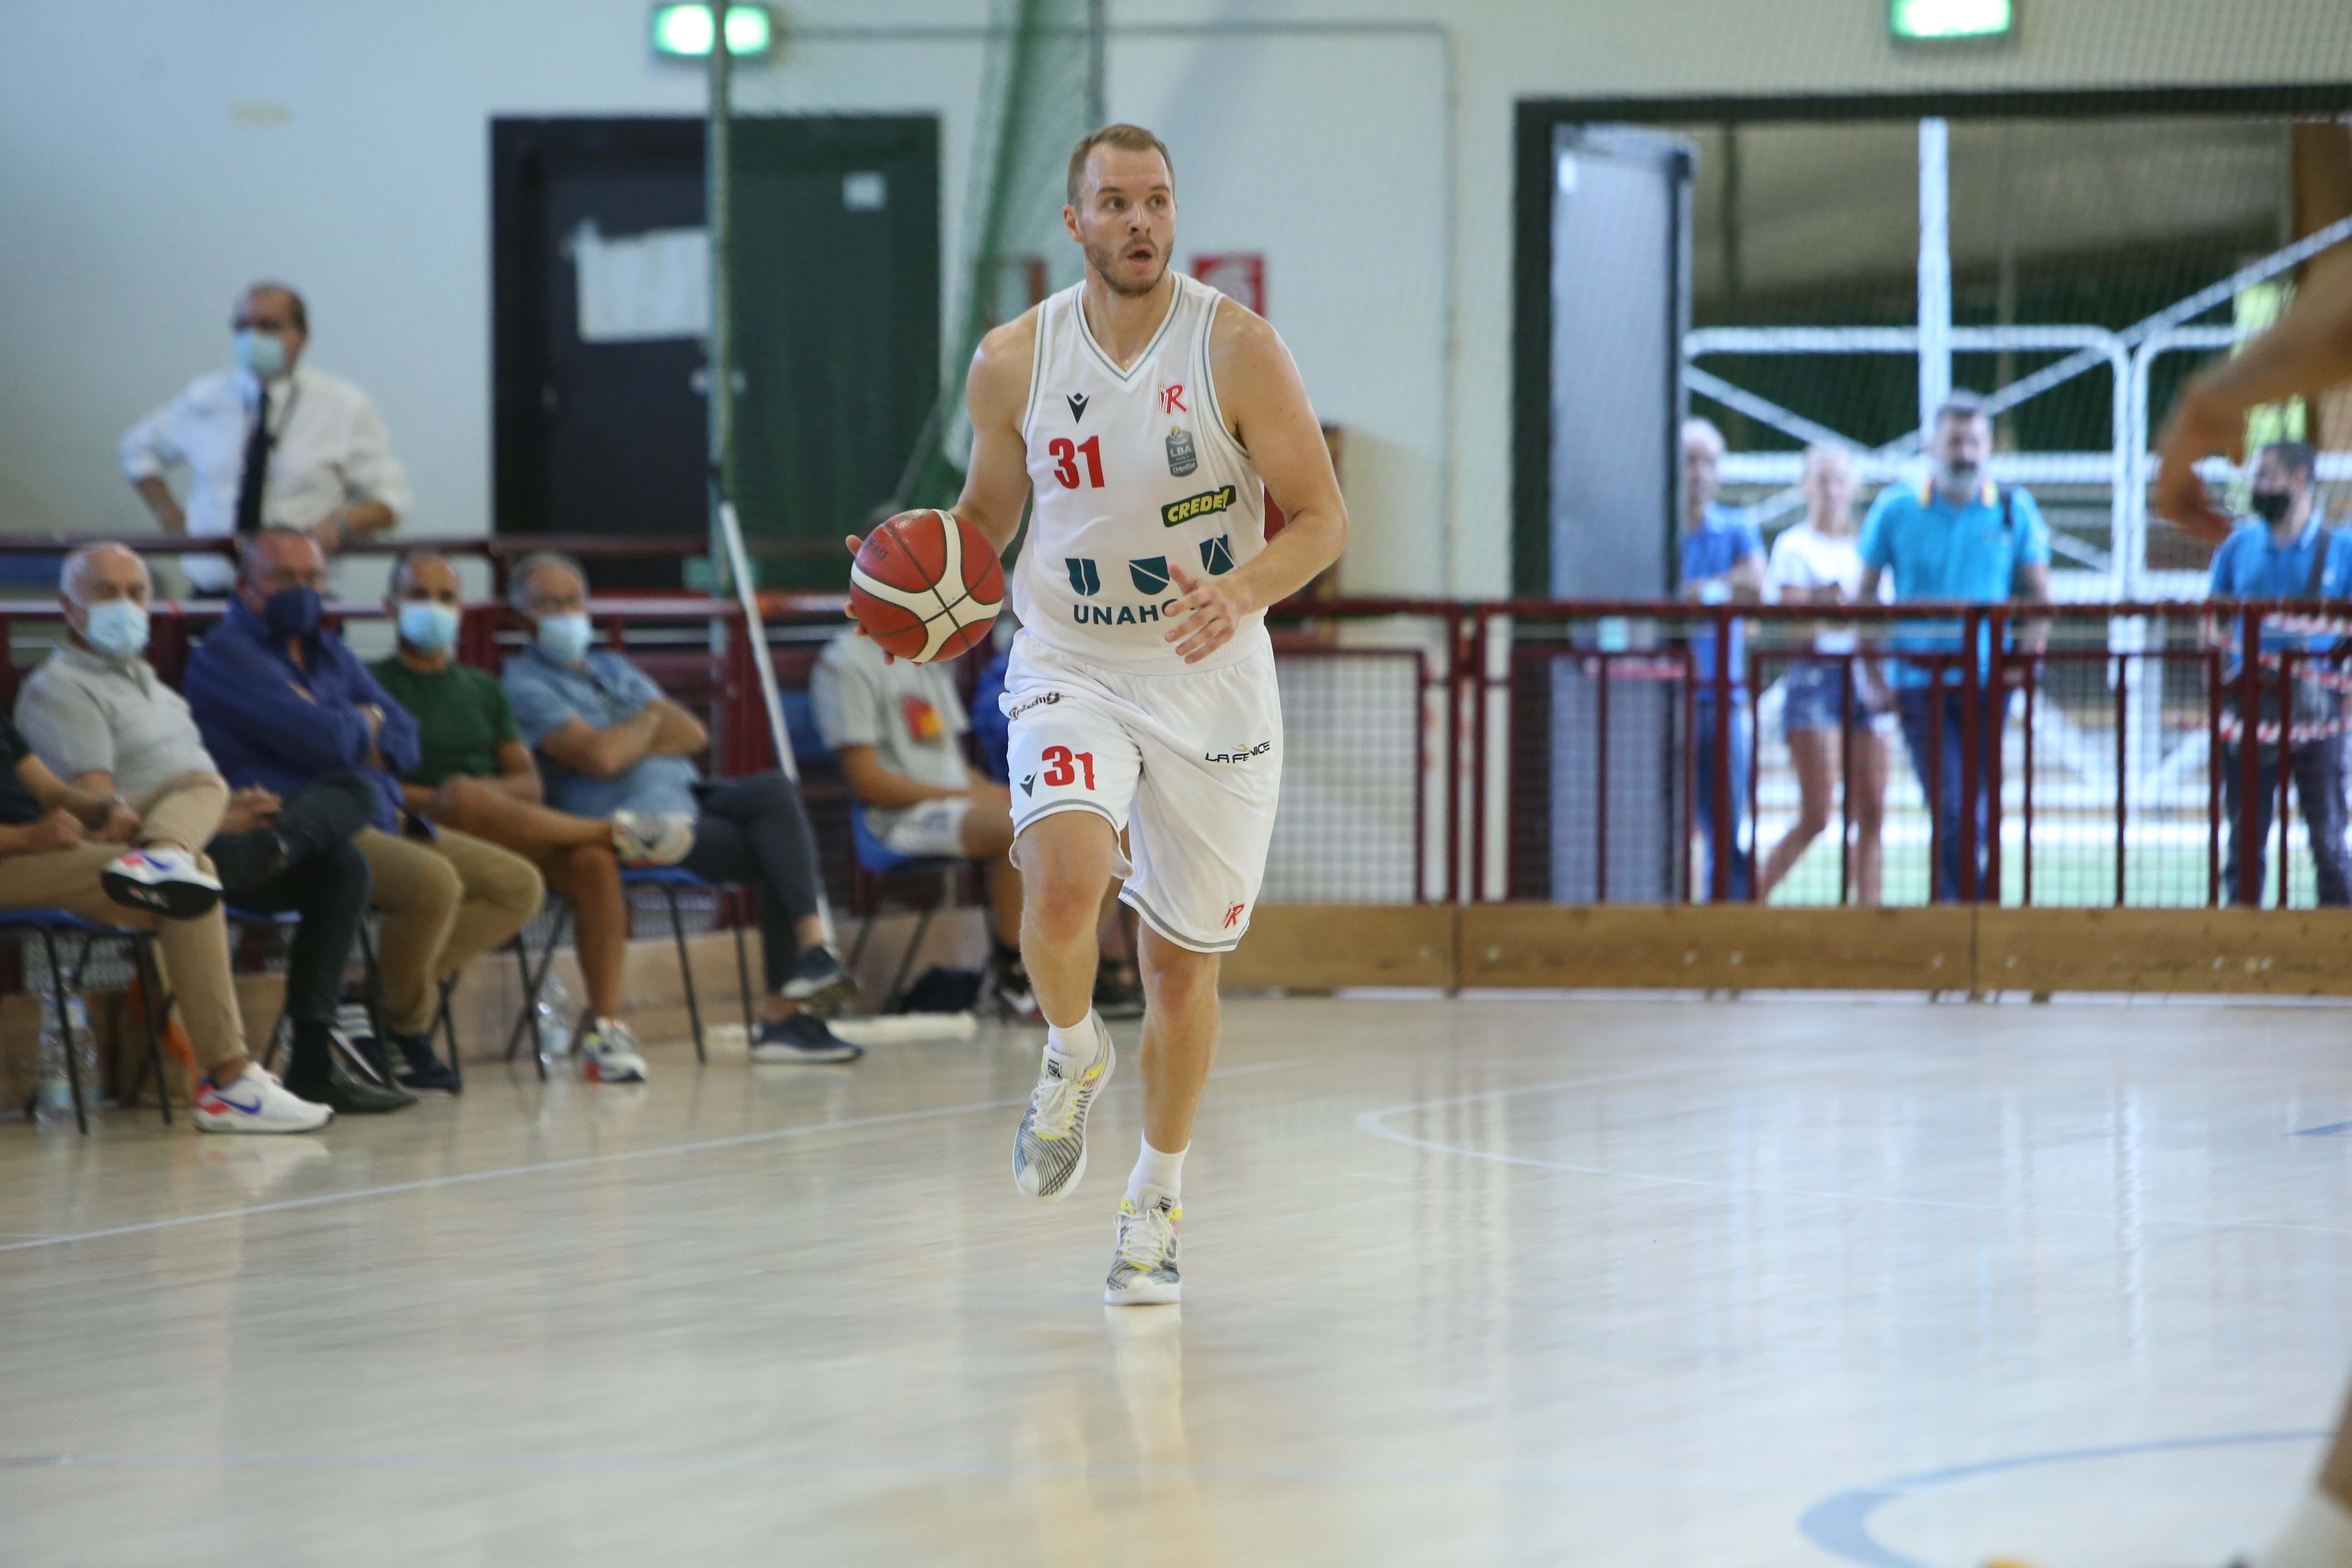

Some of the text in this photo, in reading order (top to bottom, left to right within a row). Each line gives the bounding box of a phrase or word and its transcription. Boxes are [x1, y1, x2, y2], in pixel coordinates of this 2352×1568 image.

[1049, 435, 1105, 489] 31
[1170, 445, 1193, 458] LBA
[1042, 745, 1096, 790] 31
